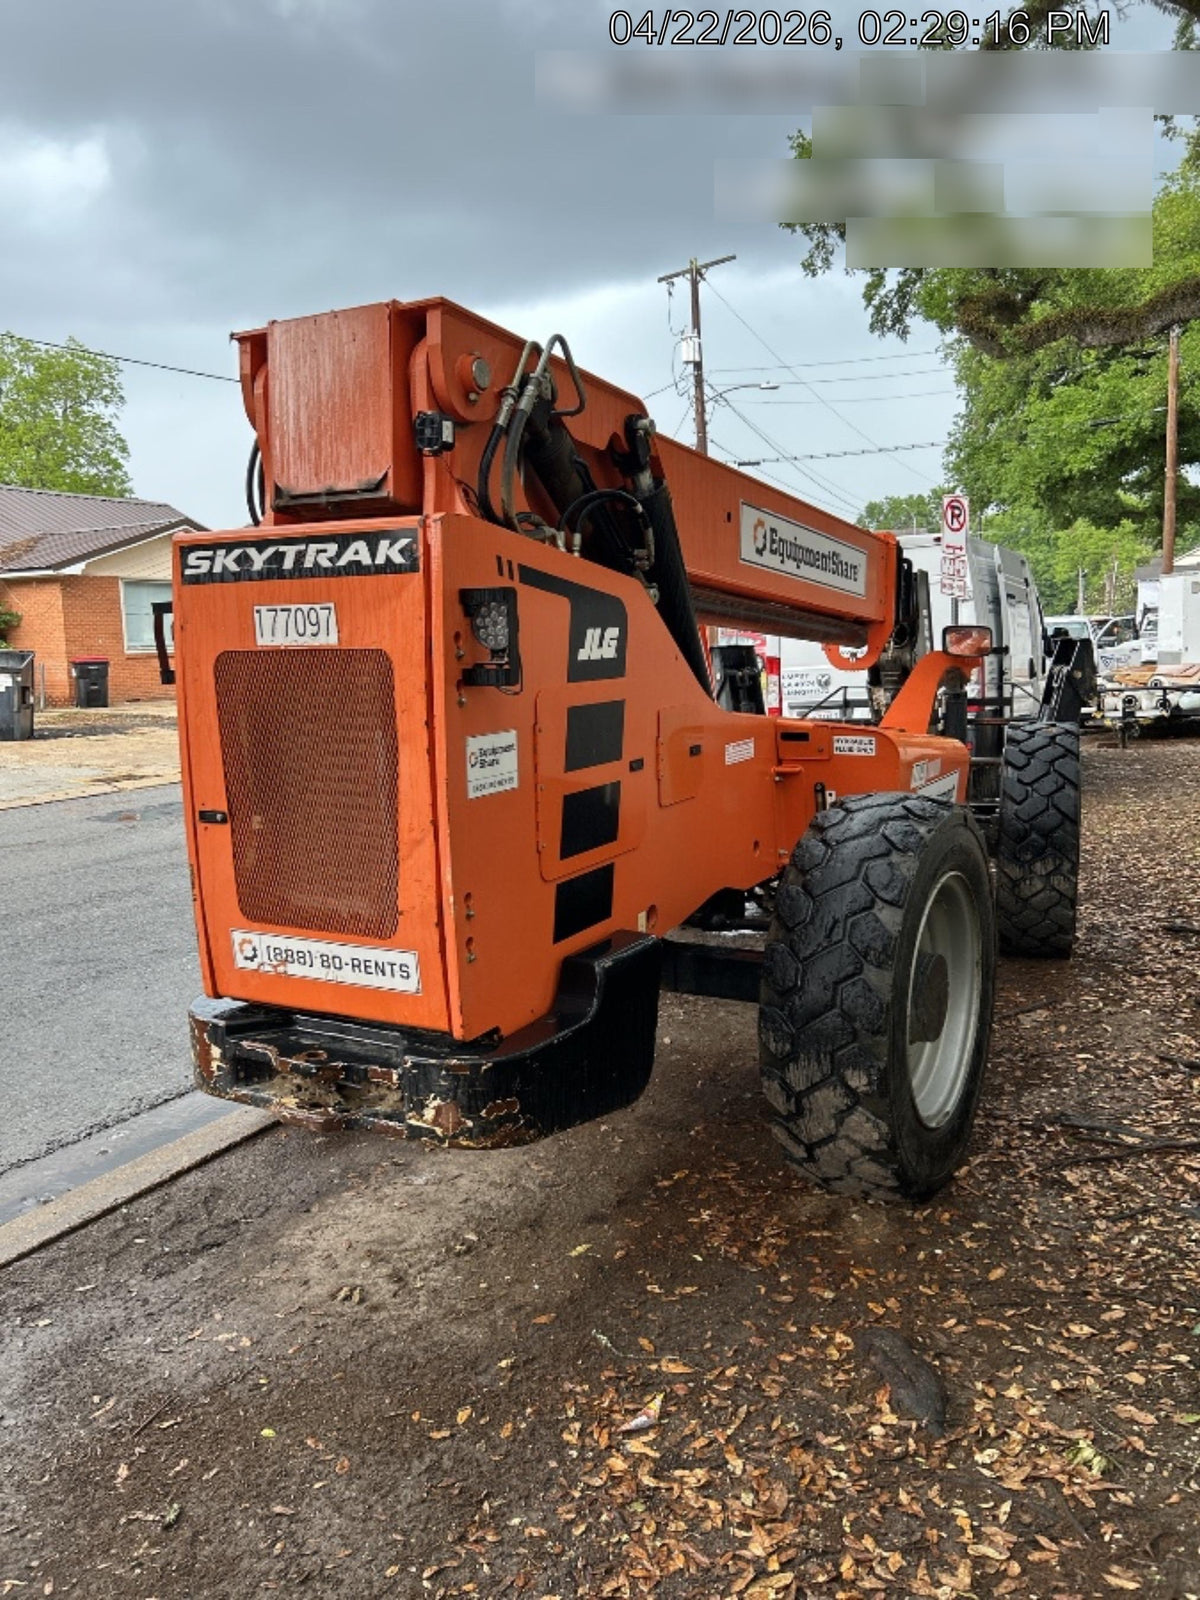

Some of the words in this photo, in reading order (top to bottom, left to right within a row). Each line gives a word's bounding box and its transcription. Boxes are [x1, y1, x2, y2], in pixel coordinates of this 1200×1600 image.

[184, 538, 412, 575] SKYTRAK
[769, 526, 859, 582] EquipmentShare
[255, 606, 332, 638] 177097
[577, 627, 620, 660] JLG
[266, 945, 314, 968] (888)
[320, 954, 411, 980] 80-RENTS
